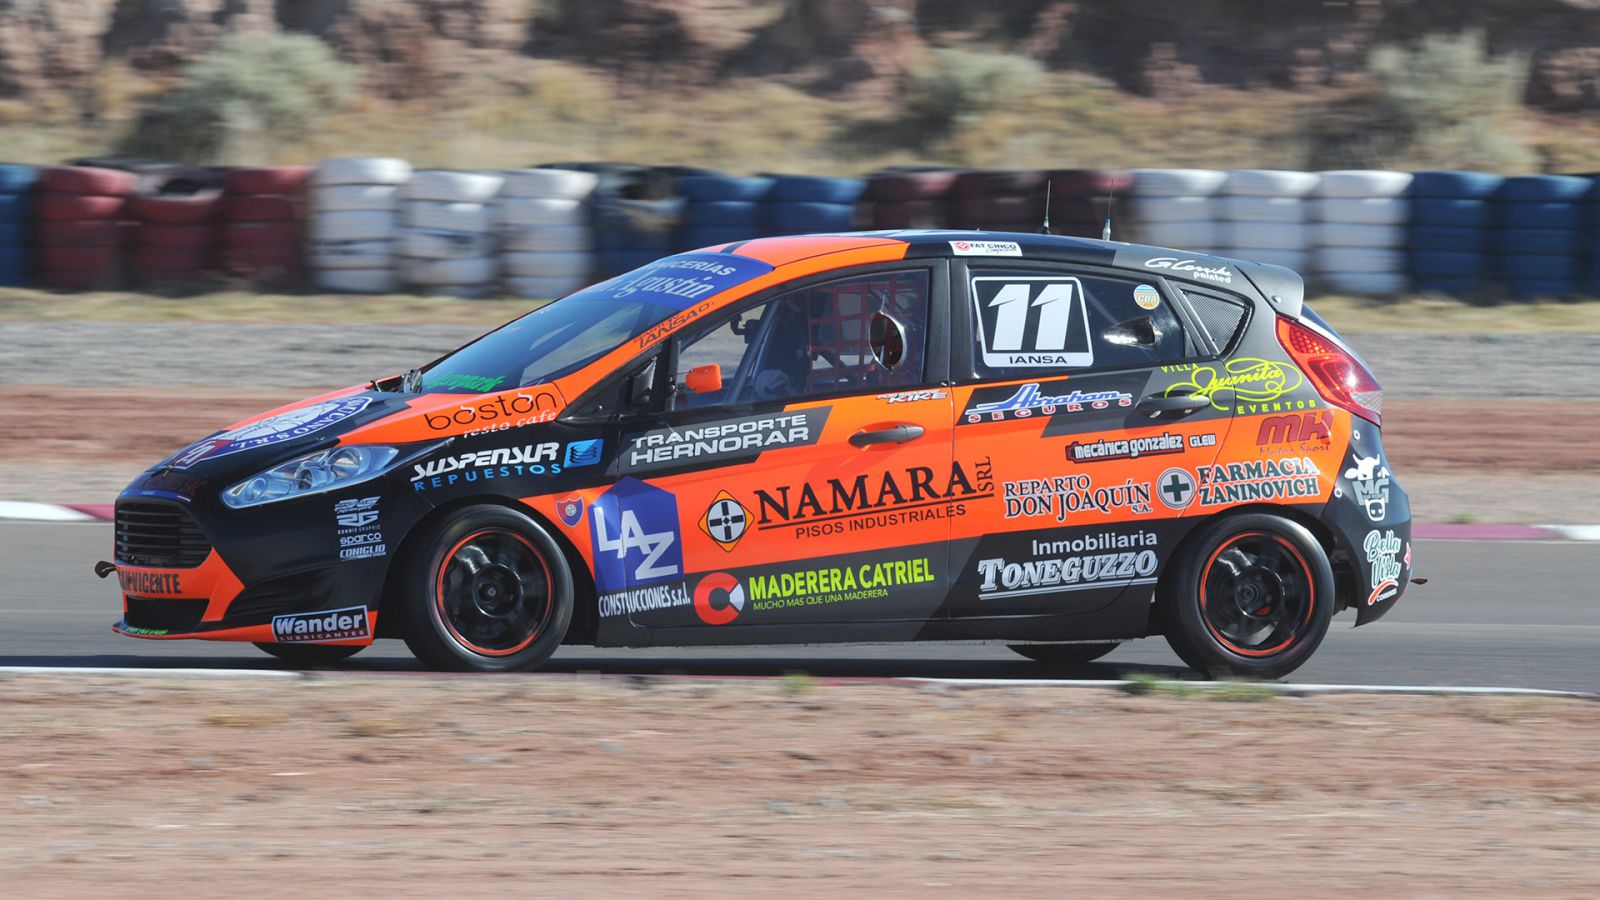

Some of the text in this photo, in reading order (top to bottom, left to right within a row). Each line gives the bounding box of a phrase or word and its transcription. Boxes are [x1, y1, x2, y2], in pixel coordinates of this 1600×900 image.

[1193, 271, 1232, 283] painted
[988, 284, 1073, 351] 11
[1009, 355, 1068, 365] IANSA
[1160, 363, 1200, 373] VILLA
[1175, 358, 1292, 404] Juanita
[424, 391, 557, 430] boston
[966, 383, 1133, 415] Abraham
[968, 398, 1132, 423] SEGUROS
[1237, 400, 1316, 415] EVENTOS
[463, 409, 557, 438] resto cafe
[631, 414, 807, 449] TRANSPORTE
[1256, 410, 1335, 446] MH
[630, 427, 809, 466] HERNORAR
[1074, 439, 1129, 459] mecánica
[1129, 432, 1183, 457] gonzalez
[410, 442, 560, 483] SUSPENSUR
[1197, 457, 1320, 485] FARMACIA
[413, 464, 562, 491] REPUESTOS
[753, 456, 995, 525] NAMARA SRL
[1003, 474, 1091, 497] REPARTO
[1199, 477, 1320, 506] ZANINOVICH
[1352, 478, 1390, 506] MG
[1005, 479, 1153, 522] DON JOAQUÍN S.A.
[795, 504, 967, 540] PISOS INDUSTRIALES
[340, 532, 382, 546] sparco
[593, 506, 679, 580] LAZ
[1032, 530, 1158, 556] Inmobiliaria
[1363, 529, 1402, 563] Bella
[749, 558, 935, 601] MADERERA CATRIEL
[977, 550, 1159, 592] TONEGUZZO
[598, 585, 672, 618] CONSTRUCCIONES
[753, 588, 889, 611] MUCHO MAS QUE UNA MADERERA
[275, 613, 363, 635] Wander
[279, 631, 365, 641] LUBRICANTES
